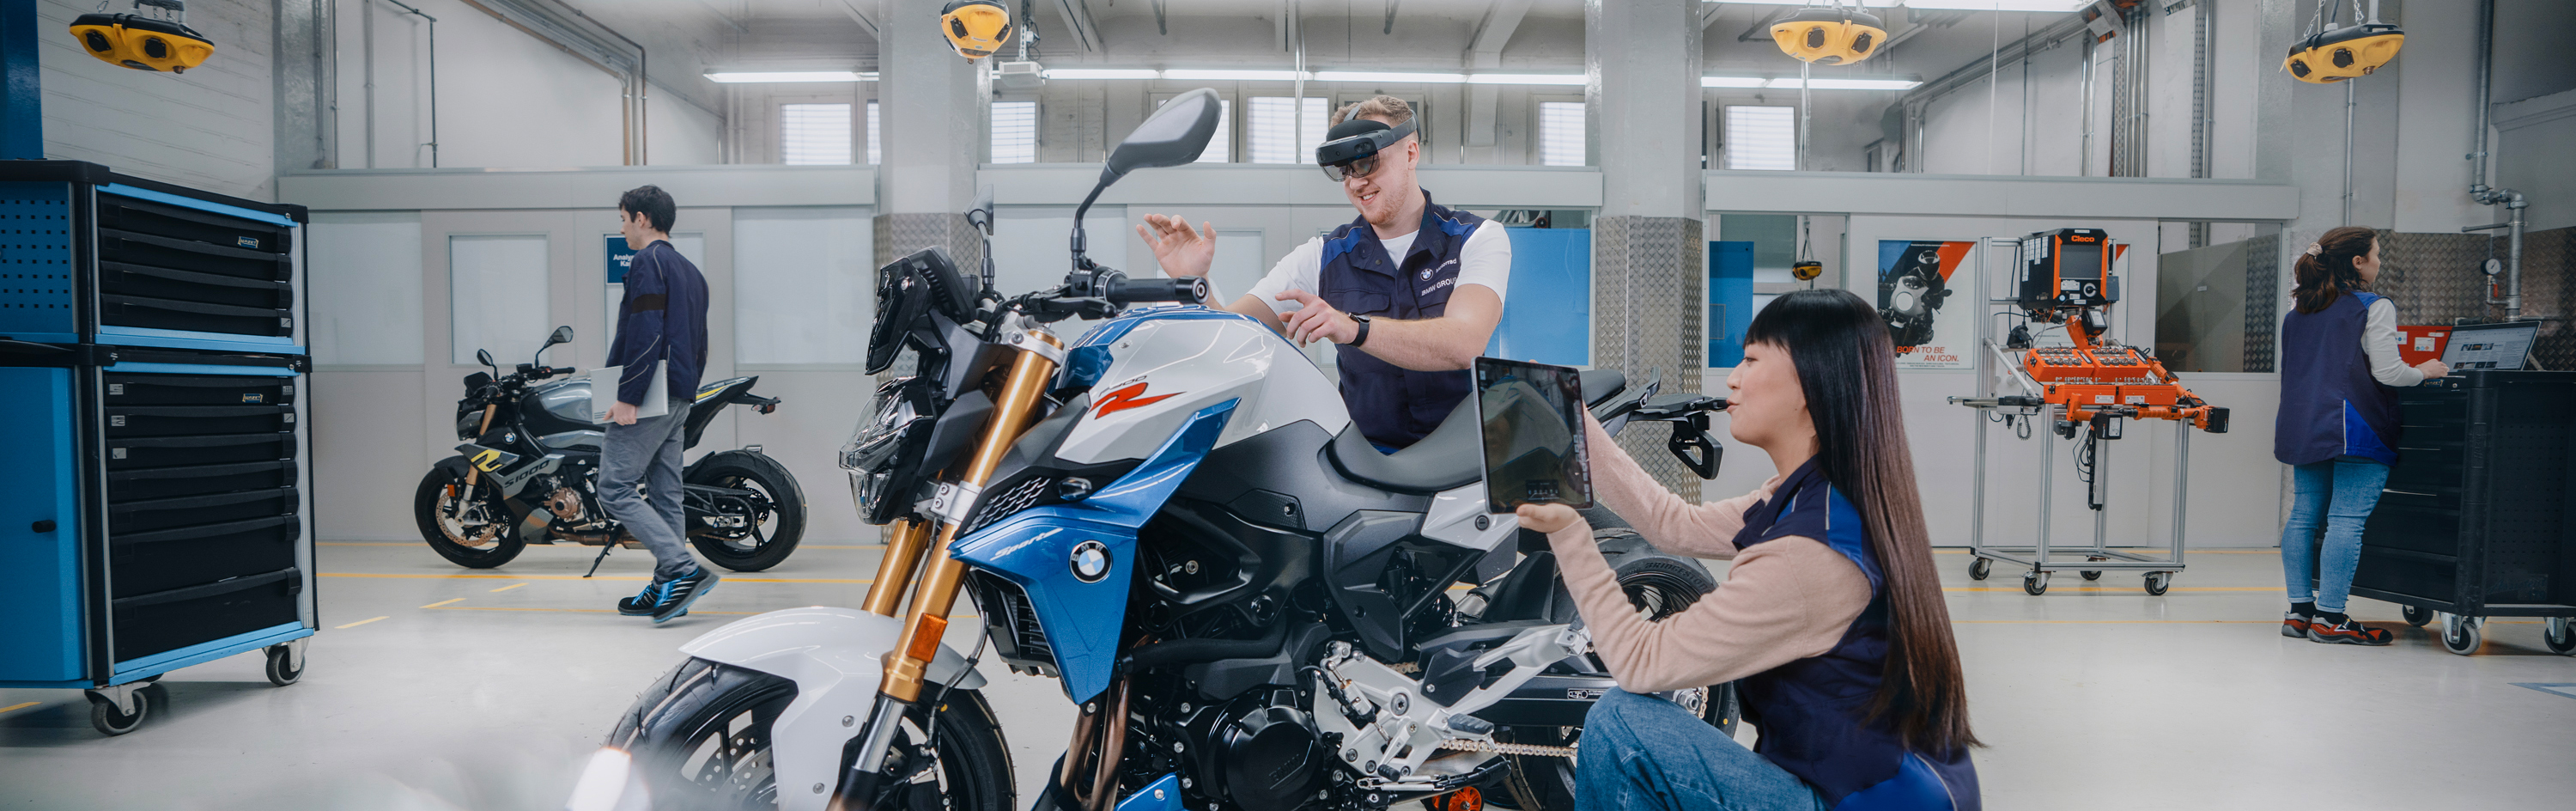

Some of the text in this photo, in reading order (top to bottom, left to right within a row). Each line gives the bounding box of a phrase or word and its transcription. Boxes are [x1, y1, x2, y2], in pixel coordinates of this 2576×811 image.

[1421, 284, 1437, 296] BMW
[1896, 345, 1920, 354] BORN
[504, 459, 550, 489] S1000
[989, 527, 1064, 562] Sport
